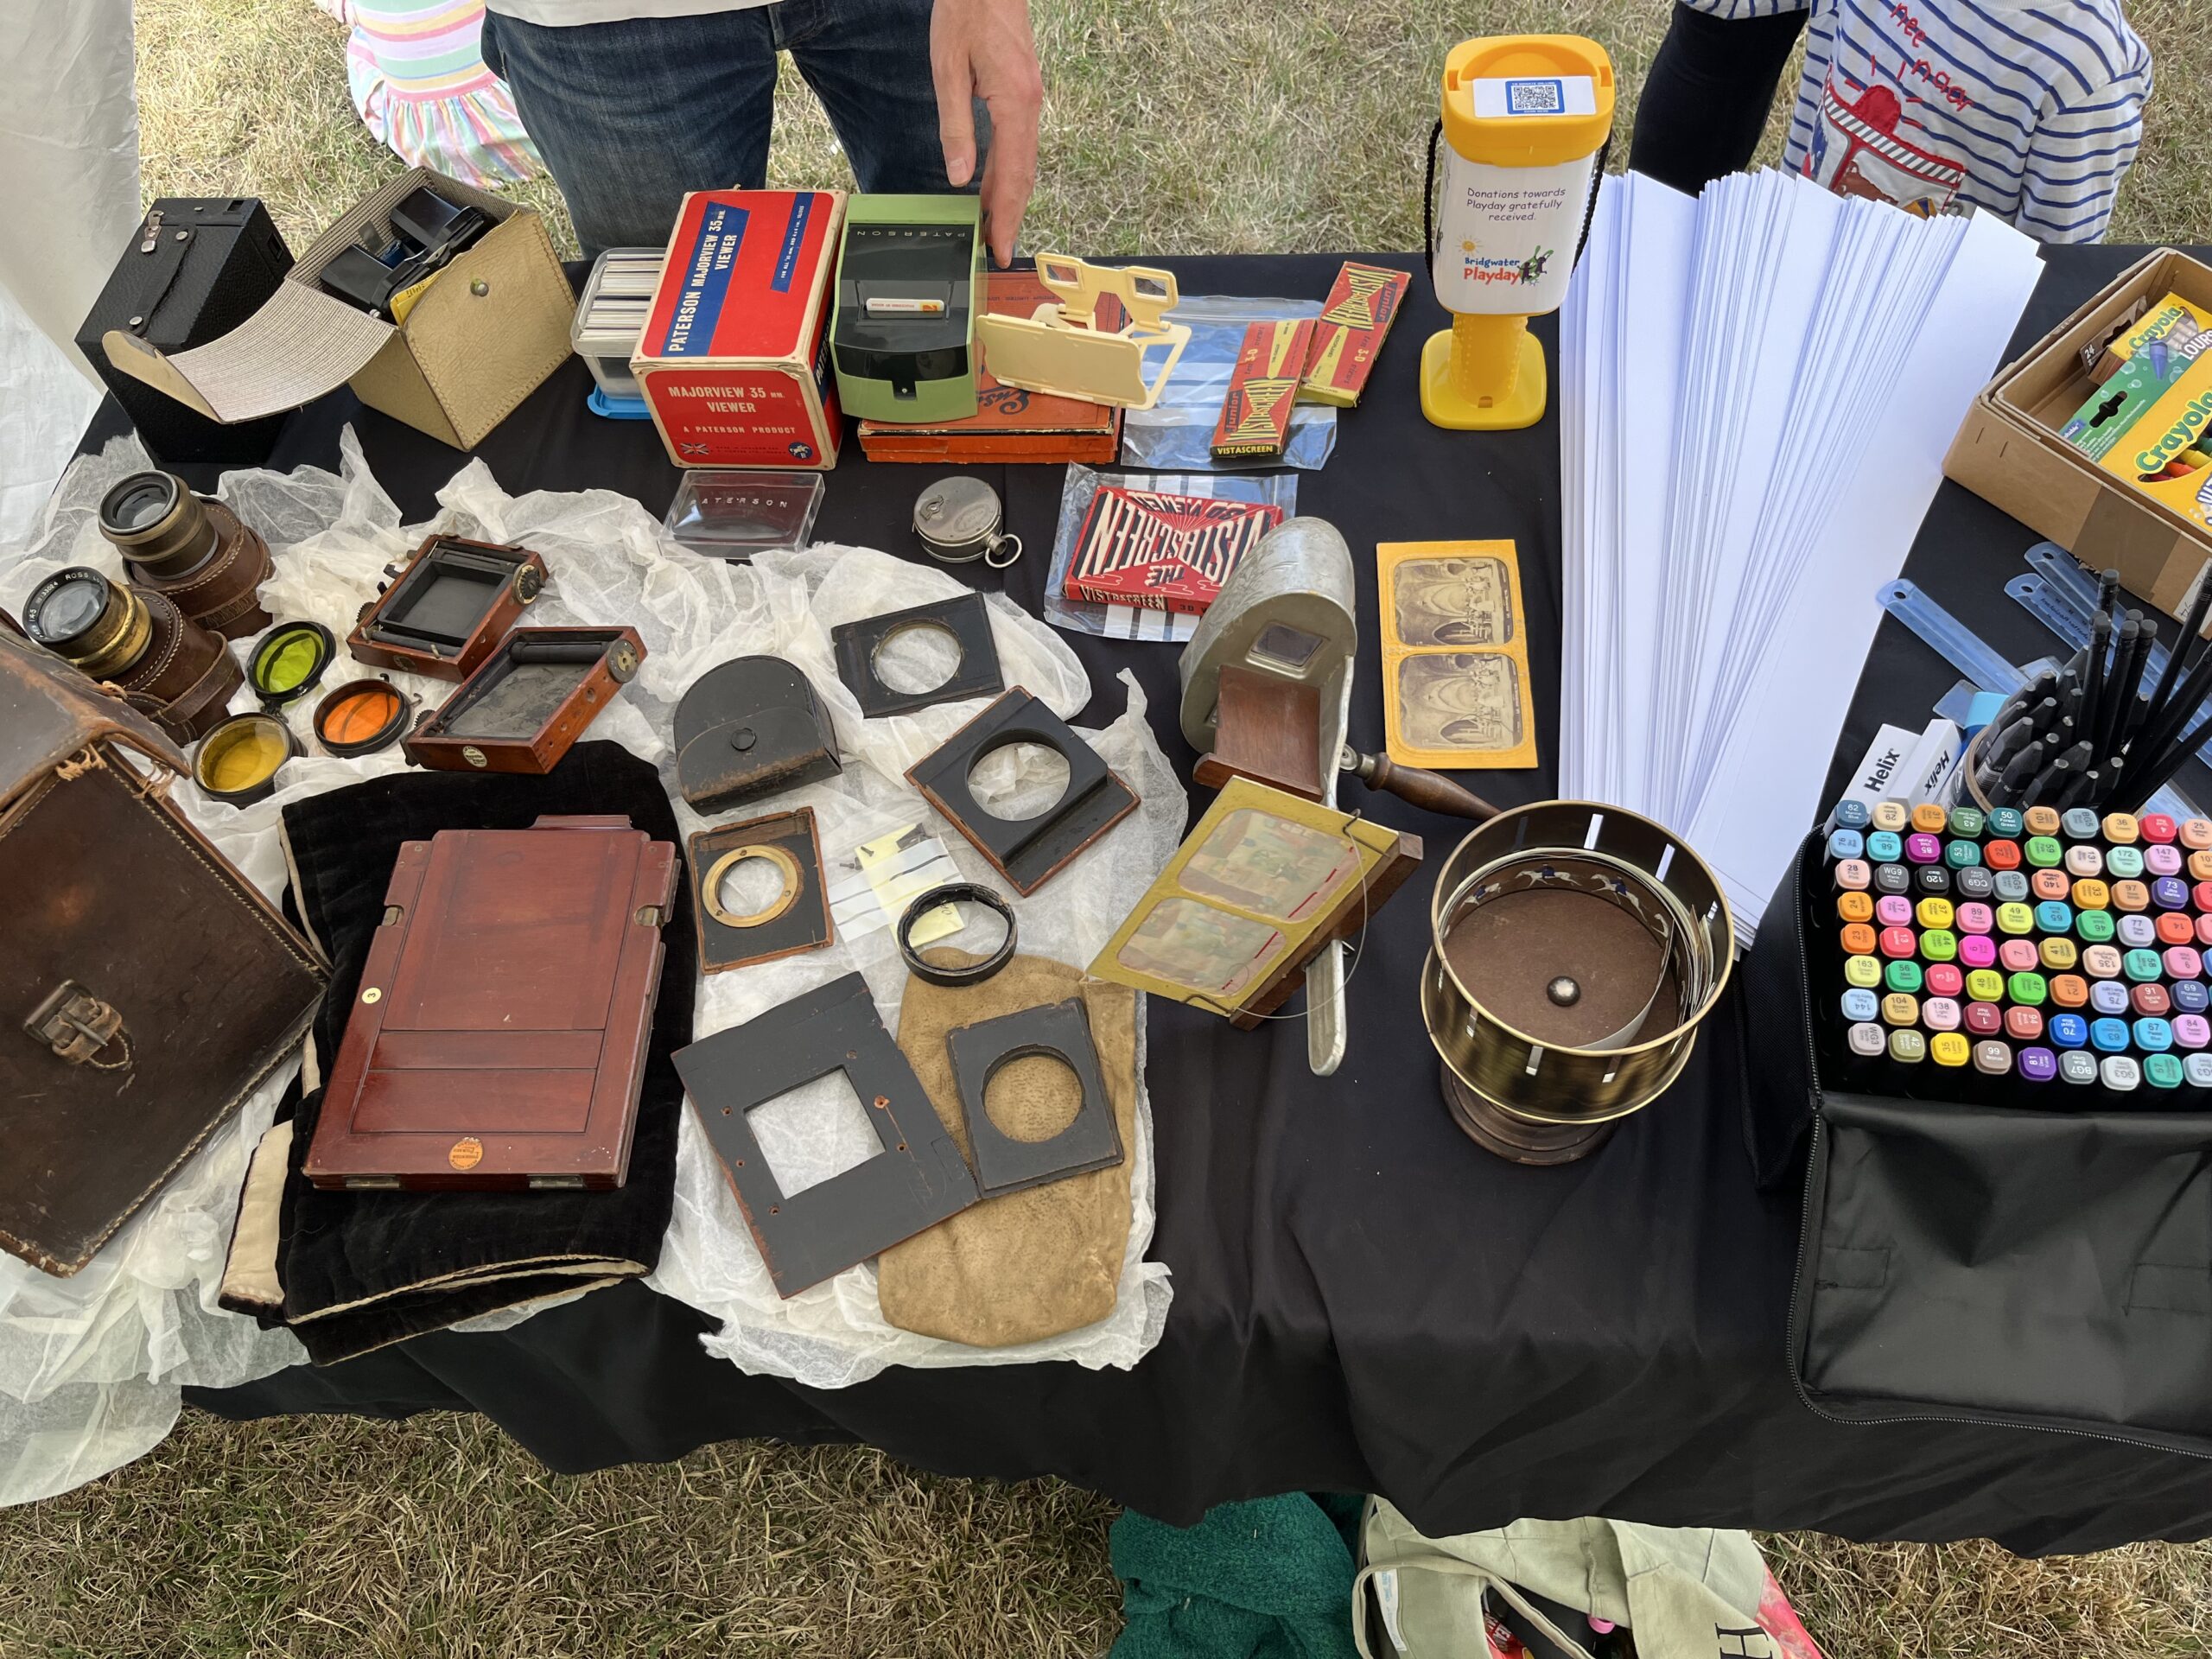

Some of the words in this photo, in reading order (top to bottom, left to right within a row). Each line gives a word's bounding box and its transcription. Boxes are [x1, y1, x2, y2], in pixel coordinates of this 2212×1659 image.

[1890, 3, 1926, 48] nee
[1467, 188, 1519, 199] Donations
[1523, 188, 1566, 197] towards
[1466, 200, 1505, 211] Playday
[1509, 200, 1562, 212] gratefully
[857, 229, 966, 238] PATERSON
[715, 235, 738, 270] VIEWER
[1465, 257, 1521, 268] Bridgwater
[1464, 266, 1521, 284] Playday
[669, 292, 702, 352] PATERSON
[691, 234, 719, 287] MAJORVIEW
[709, 220, 724, 232] 35
[1321, 267, 1397, 330] VISTASCREEN
[1378, 285, 1392, 320] junior
[2129, 308, 2182, 349] Crayola
[2179, 330, 2212, 360] LOURS
[1245, 348, 1258, 362] 3-D
[1355, 350, 1370, 363] 3-D
[2085, 345, 2095, 359] 24
[668, 386, 743, 397] MAJORVIEW
[750, 388, 766, 397] 35
[707, 402, 756, 413] VIEWER
[1225, 378, 1296, 442] VISTASCREEN
[1225, 392, 1239, 431] junior
[1217, 445, 1273, 455] VISTASCREEN
[1128, 492, 1202, 517] VIEWER
[1206, 501, 1247, 520] 3D
[1077, 490, 1270, 587] VISTASCREEN
[1145, 564, 1185, 587] THE
[1080, 585, 1166, 611] VISTASCREEN
[1864, 749, 1901, 792] Helix
[1924, 750, 1949, 791] Helix
[2082, 811, 2094, 827] BG5
[1838, 837, 1847, 847] 76
[1954, 848, 1962, 856] 53
[2045, 844, 2055, 853] 59
[2088, 851, 2096, 864] 131
[1884, 867, 1902, 875] WG9
[2012, 874, 2022, 890] GG5
[2092, 887, 2101, 897] 33
[1850, 899, 1858, 909] 24
[1897, 904, 1905, 912] 17
[1938, 905, 1948, 913] 37
[1853, 931, 1861, 940] 23
[1901, 933, 1909, 944] 13
[1943, 936, 1951, 945] 44
[2050, 945, 2058, 955] 41
[2098, 959, 2116, 968] 135
[2148, 958, 2156, 968] 58
[1977, 978, 1985, 988] 48
[2033, 981, 2042, 991] 47
[1854, 1002, 1872, 1011] 144
[2028, 1014, 2038, 1024] 94
[1869, 1026, 1879, 1046] WG3
[1911, 1036, 1921, 1047] 42
[1942, 1042, 1950, 1052] 35
[1987, 1046, 2000, 1055] 99
[2029, 1055, 2037, 1065] 81
[1714, 1623, 1773, 1659] H
